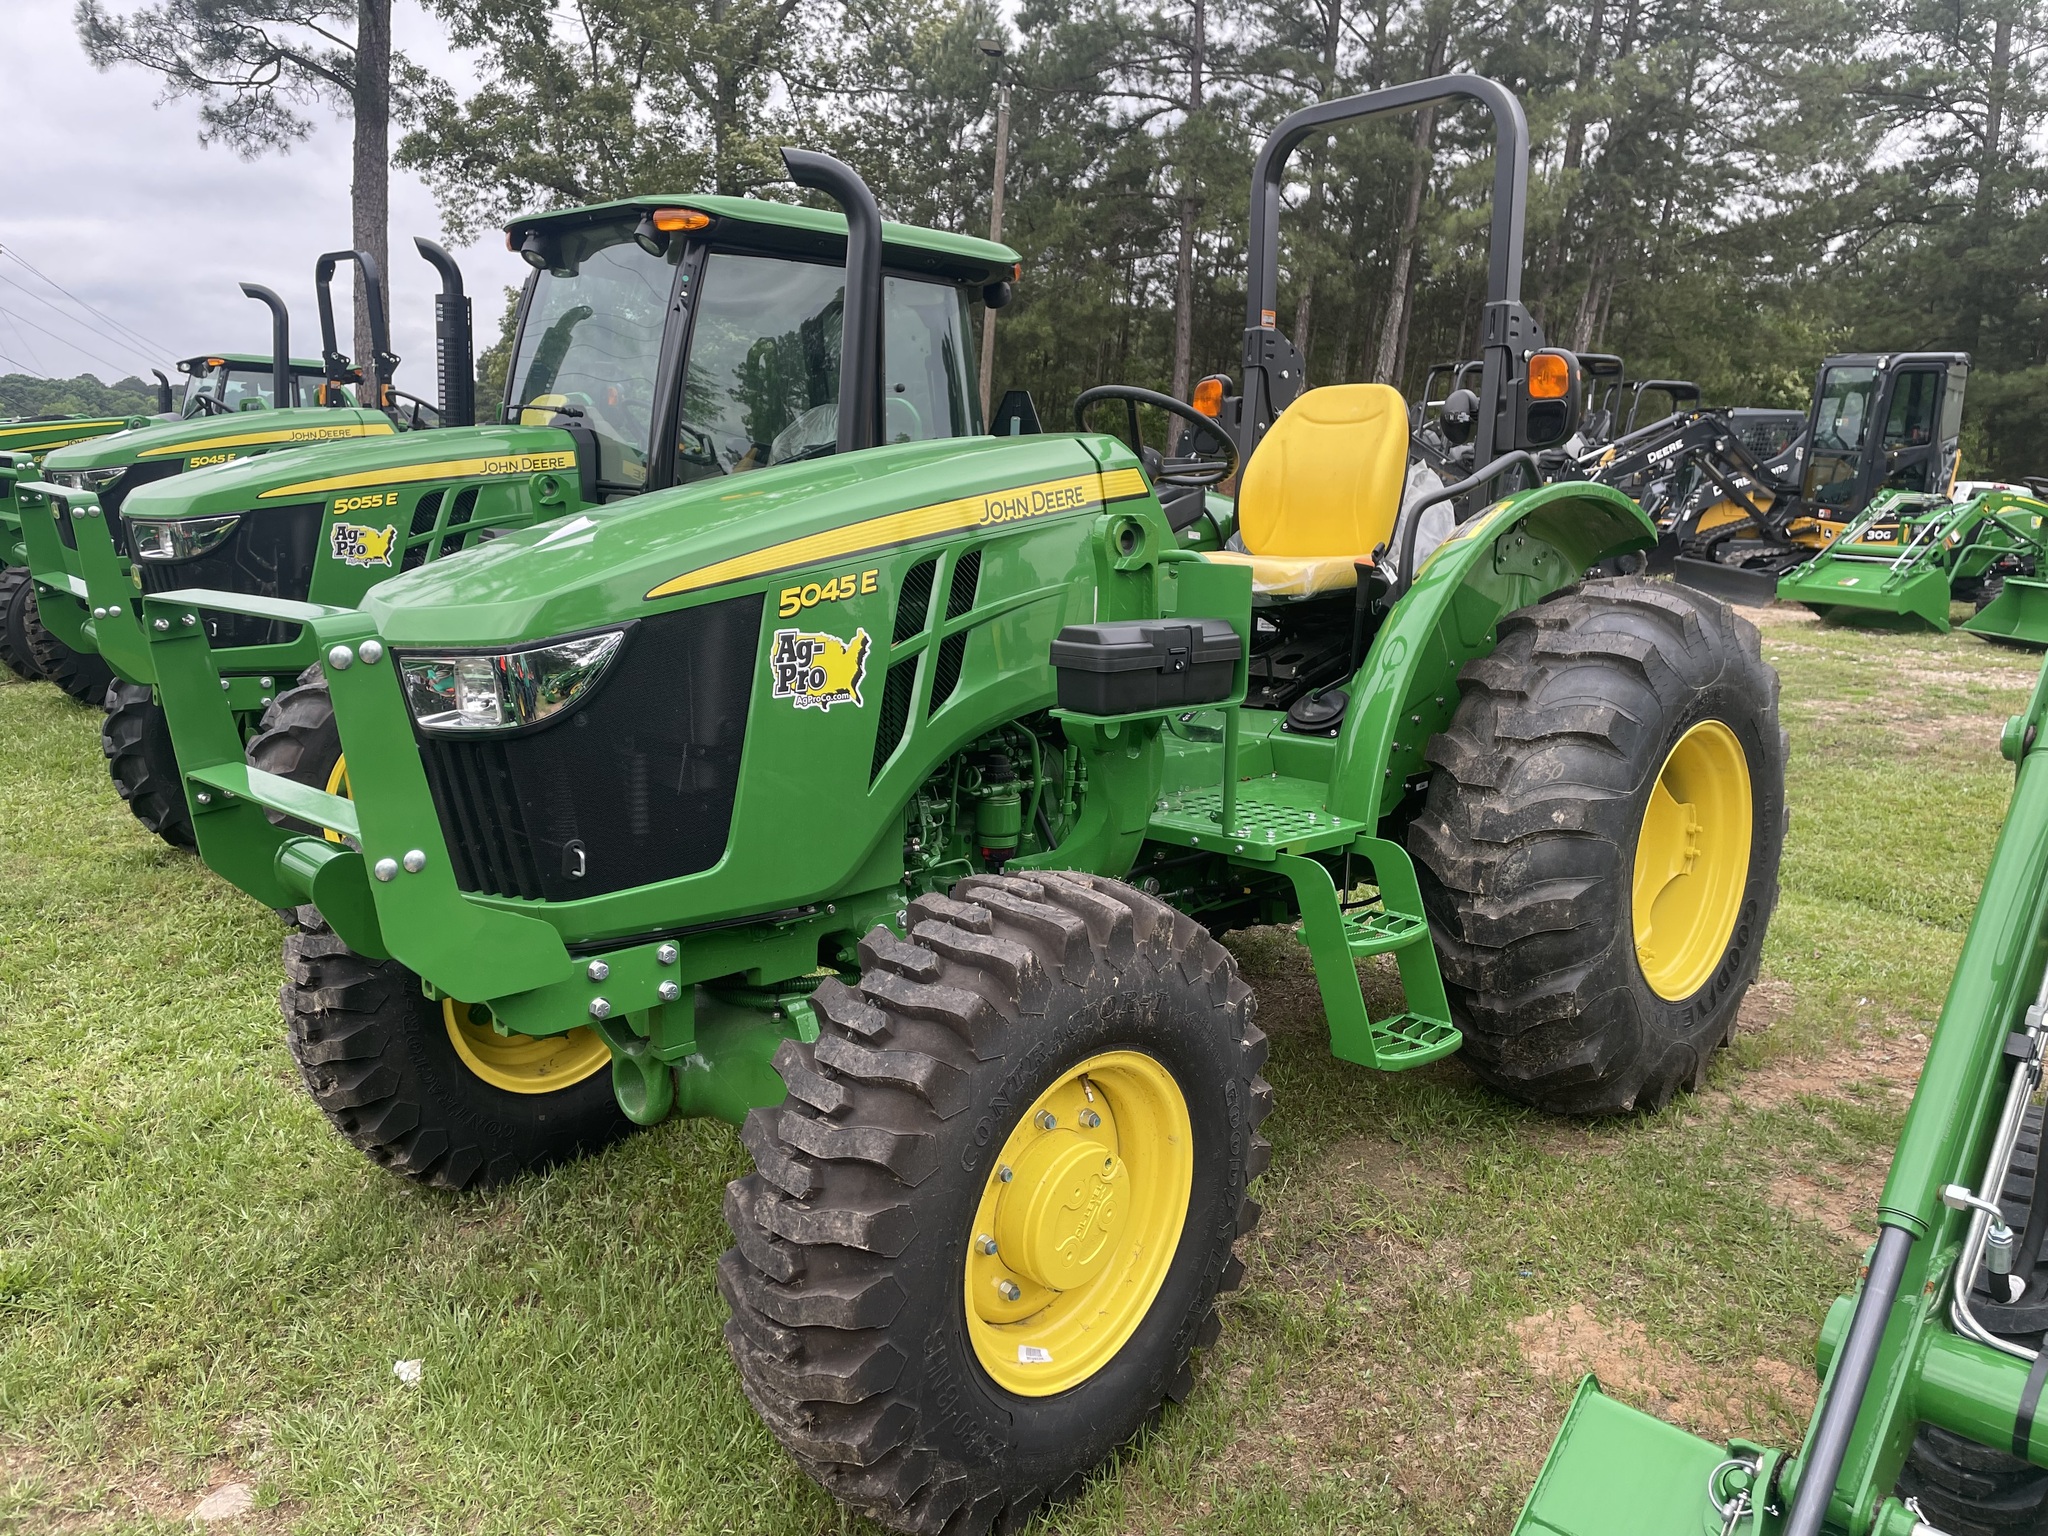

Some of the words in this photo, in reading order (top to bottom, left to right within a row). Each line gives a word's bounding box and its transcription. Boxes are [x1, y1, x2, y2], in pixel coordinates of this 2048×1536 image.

[289, 430, 317, 441] JOHN
[318, 428, 352, 438] DEERE
[1647, 438, 1684, 464] DEERE
[190, 456, 226, 468] 5045
[480, 460, 519, 475] JOHN
[521, 457, 566, 471] DEERE
[333, 494, 383, 515] 5055
[385, 492, 399, 506] E
[979, 496, 1030, 525] JOHN
[1031, 486, 1086, 514] DEERE
[335, 526, 365, 543] Ag-
[1866, 530, 1892, 540] 30G
[335, 541, 366, 556] Pro
[778, 573, 858, 618] 5045
[860, 568, 880, 595] E
[775, 634, 824, 668] Ag-
[777, 663, 826, 694] Pro
[795, 692, 850, 706] AgProCo.com
